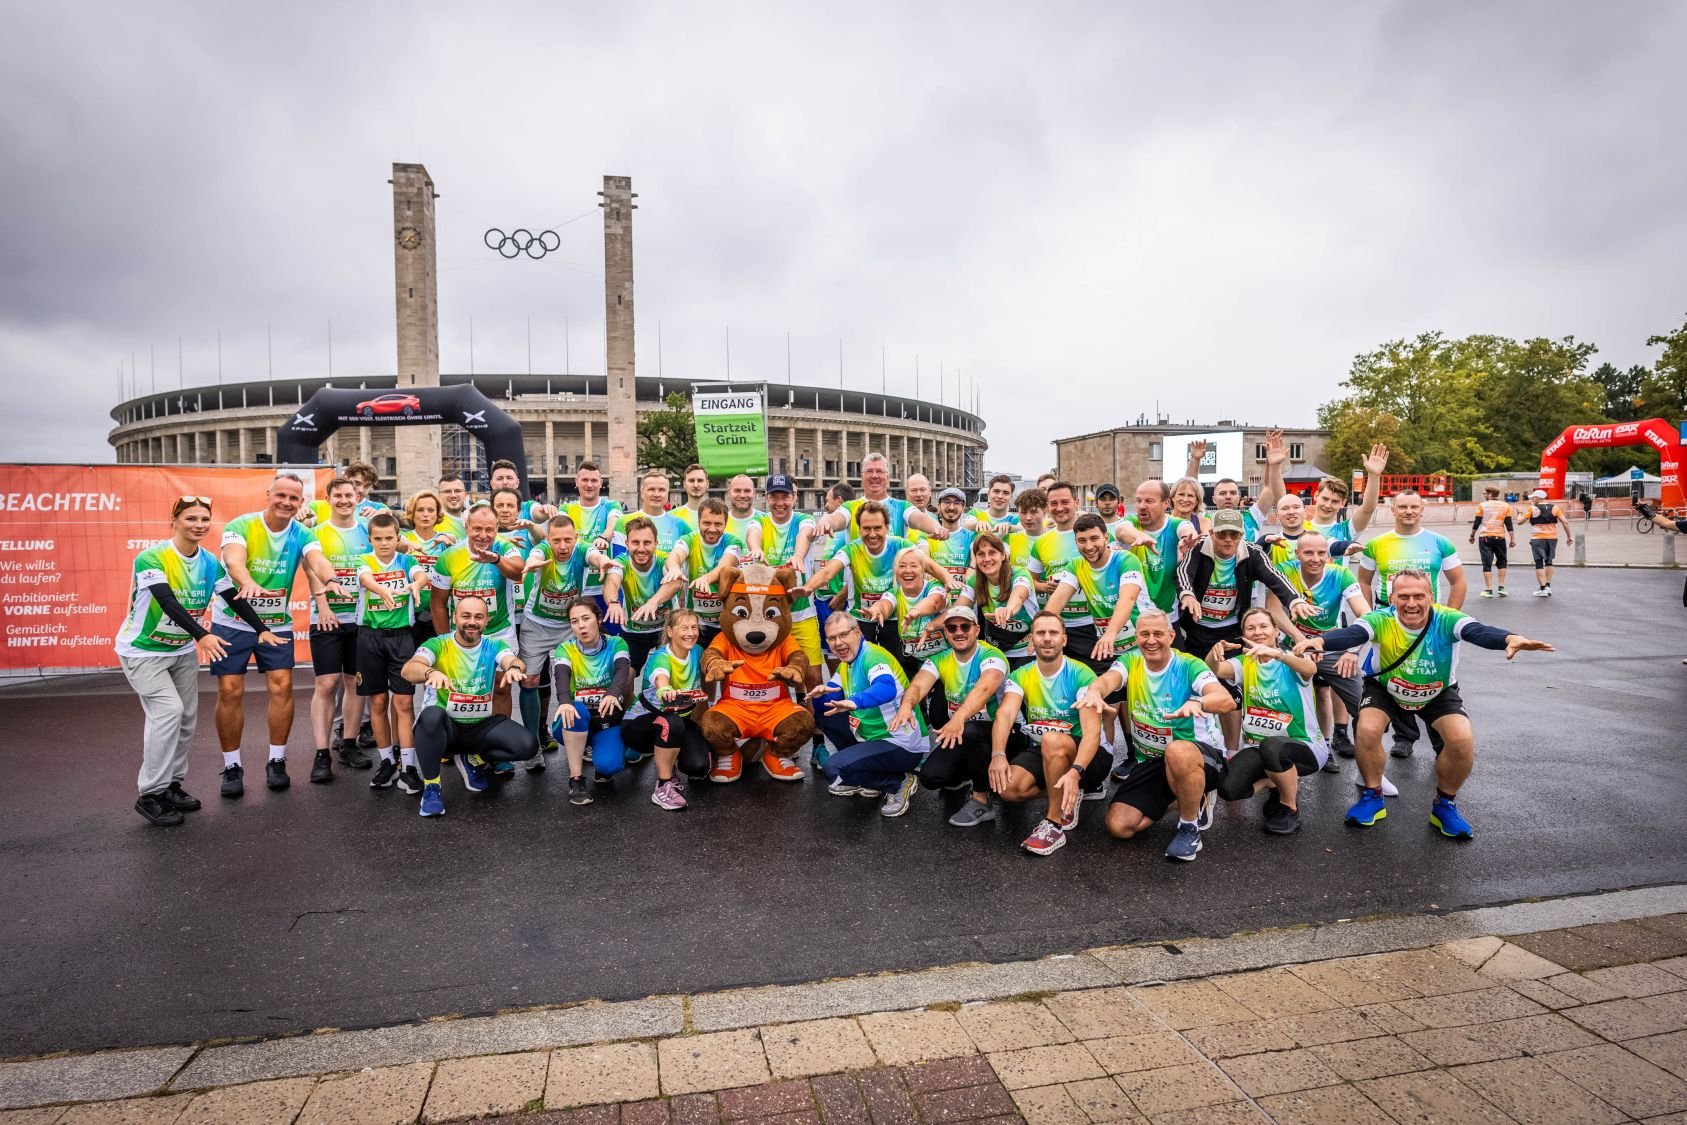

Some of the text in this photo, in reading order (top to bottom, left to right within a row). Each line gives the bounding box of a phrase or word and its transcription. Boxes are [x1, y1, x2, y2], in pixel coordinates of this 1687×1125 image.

[701, 398, 754, 410] EINGANG
[704, 422, 756, 433] Startzeit
[716, 434, 746, 445] Grün
[1645, 429, 1668, 448] START
[1546, 435, 1566, 456] START
[0, 540, 54, 550] ELLUNG
[0, 560, 55, 570] Wie willst
[2, 572, 61, 586] du laufen?
[3, 592, 78, 603] Ambitioniert:
[250, 598, 282, 608] 6295
[1204, 596, 1232, 605] 6327
[698, 599, 722, 608] 1626
[4, 604, 107, 616] VORNE aufstellen
[6, 623, 68, 634] Gemütlich:
[8, 635, 112, 647] HINTEN aufstellen
[1394, 684, 1436, 698] 16240
[581, 696, 602, 704] 162
[452, 704, 488, 712] 16311
[1030, 706, 1070, 717] ONE SPIE
[1248, 716, 1282, 730] 16250
